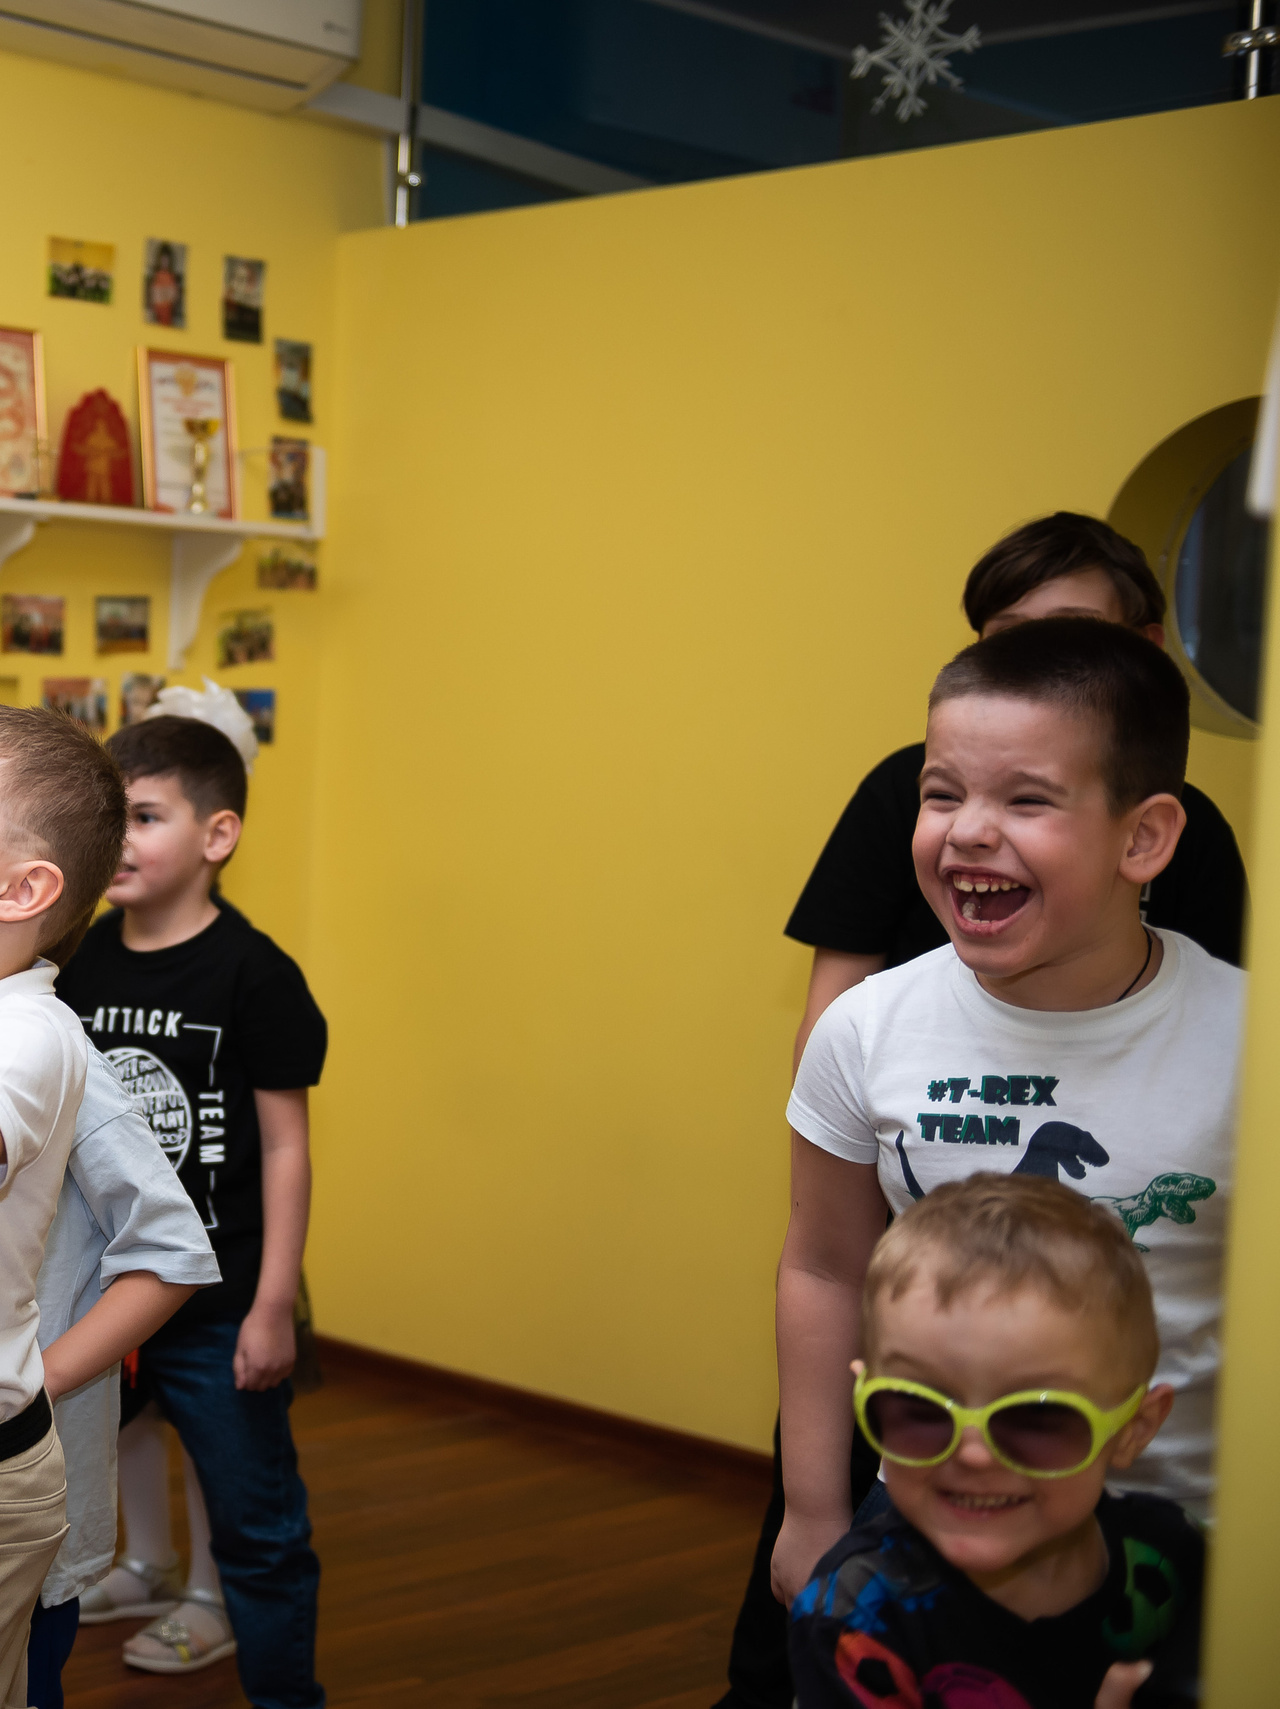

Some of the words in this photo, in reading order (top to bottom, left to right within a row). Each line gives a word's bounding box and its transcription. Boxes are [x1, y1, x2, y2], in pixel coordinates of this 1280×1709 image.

[92, 1006, 182, 1038] ATTACK
[927, 1075, 1060, 1107] #T-REX
[152, 1110, 185, 1130] PLAY
[198, 1089, 225, 1164] TEAM
[917, 1112, 1021, 1147] TEAM
